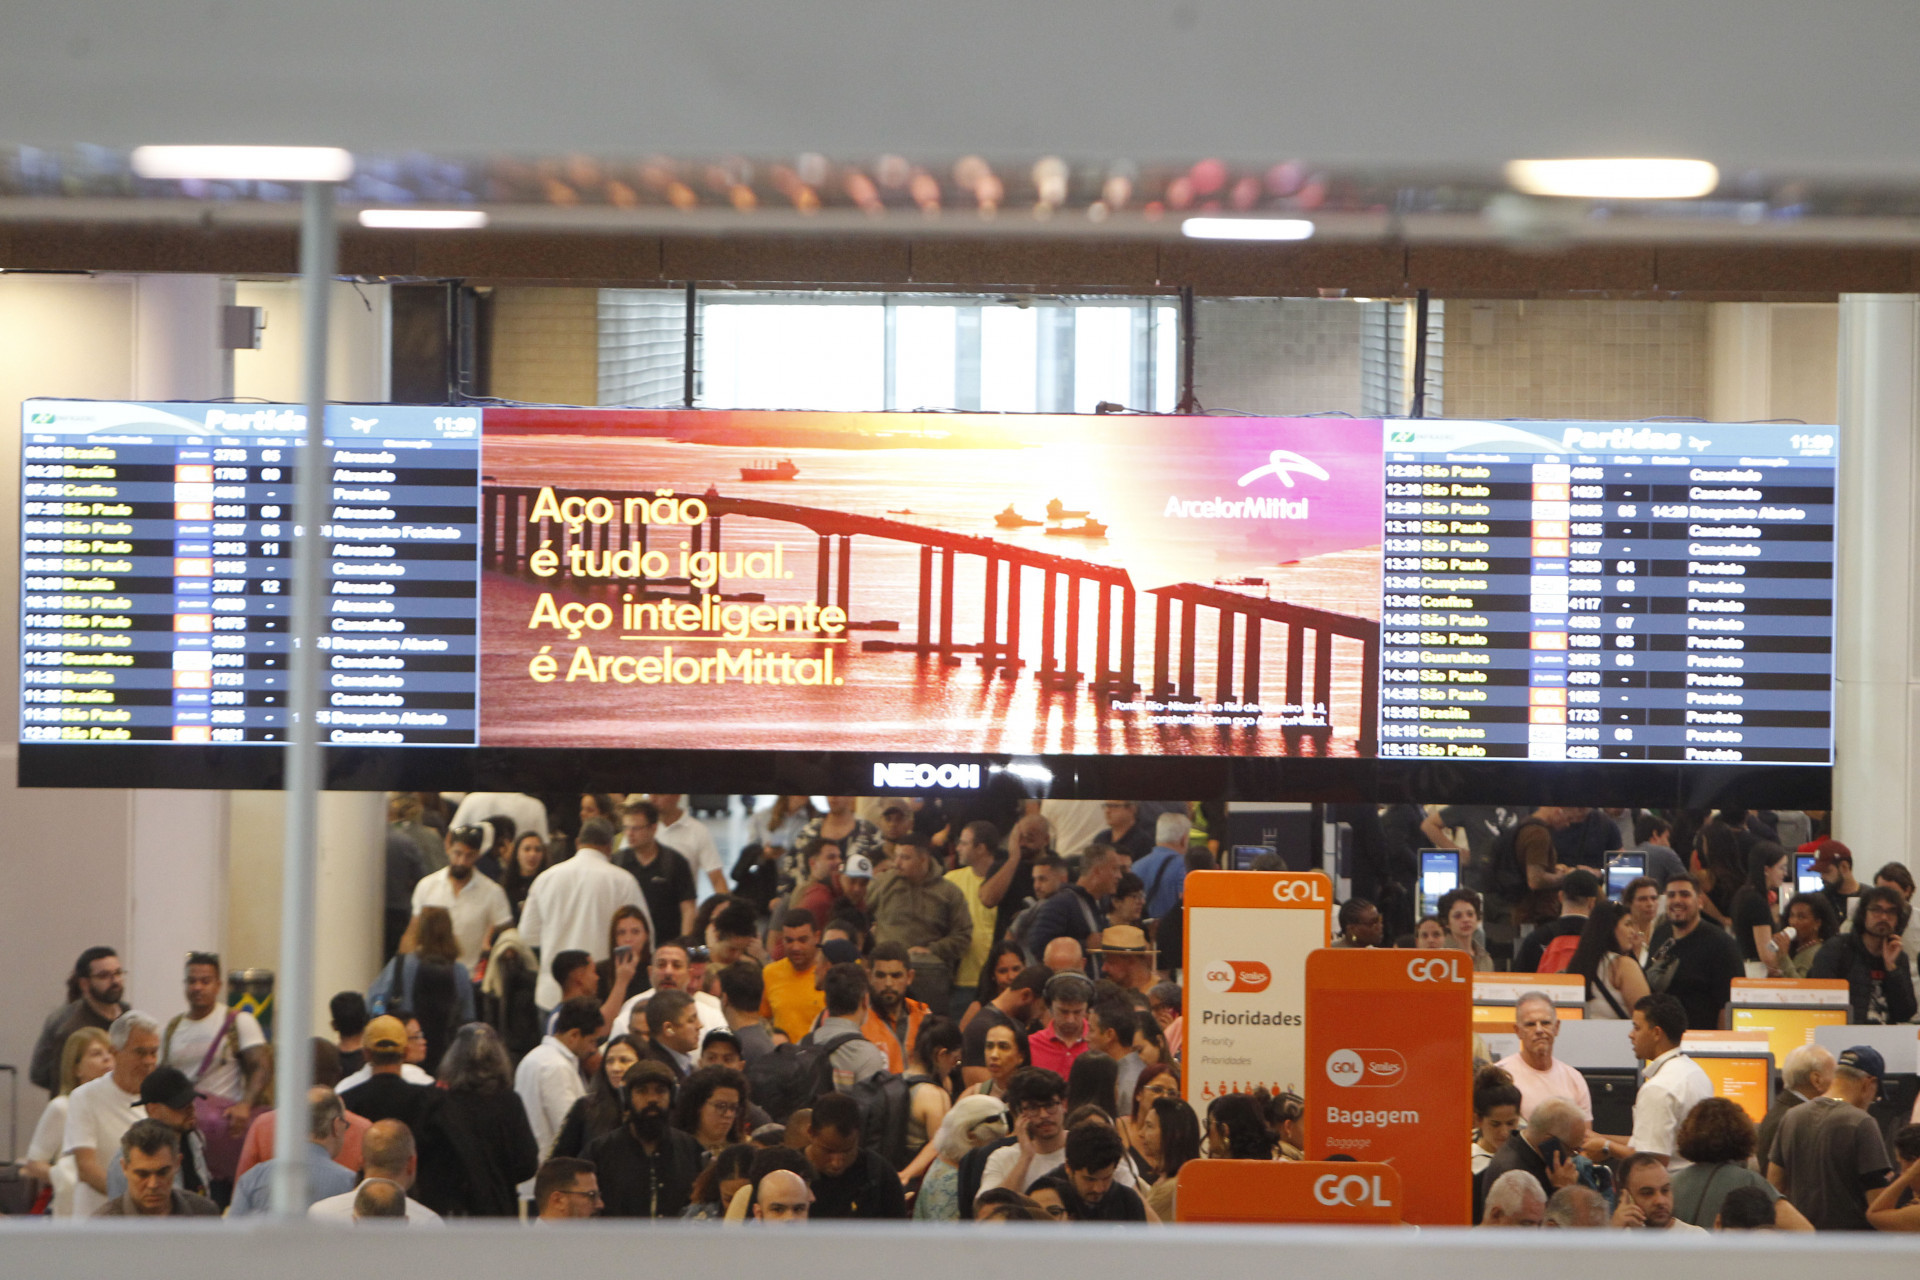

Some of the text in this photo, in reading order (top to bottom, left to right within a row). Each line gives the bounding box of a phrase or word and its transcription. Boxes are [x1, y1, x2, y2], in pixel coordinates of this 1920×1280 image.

[205, 410, 307, 430] Partida
[1562, 428, 1682, 450] Partidas
[1422, 465, 1449, 477] São
[1451, 466, 1490, 478] Paulo
[1423, 484, 1449, 495] São
[1451, 484, 1489, 496] Paulo
[530, 486, 708, 534] Aço não
[1163, 496, 1308, 519] ArcelorMittal
[1421, 502, 1449, 514] São
[1451, 503, 1489, 515] Paulo
[1422, 521, 1448, 533] São
[1451, 522, 1489, 533] Paulo
[262, 543, 278, 554] 11
[1421, 539, 1448, 551] São
[1450, 540, 1489, 552] Paulo
[530, 540, 794, 588] é tudo igual.
[1421, 558, 1448, 570] São
[1450, 559, 1488, 570] Paulo
[262, 580, 279, 592] 12
[1569, 598, 1601, 609] 4117
[528, 593, 847, 640] Aço inteligente
[1420, 614, 1447, 626] São
[1449, 614, 1488, 626] Paulo
[1420, 632, 1447, 644] São
[1449, 633, 1487, 645] Paulo
[529, 646, 844, 685] é ArcelorMittal.
[1420, 670, 1446, 681] São
[1449, 670, 1487, 682] Paulo
[1419, 688, 1446, 700] São
[1448, 689, 1487, 701] Paulo
[1418, 744, 1445, 756] São
[1447, 745, 1485, 757] Paulo
[873, 763, 980, 788] NEOOH
[1273, 880, 1325, 902] GOL
[1407, 957, 1466, 983] GOL
[1206, 971, 1269, 983] GOL Smiles
[1202, 1010, 1302, 1026] Prioridades
[1201, 1036, 1235, 1048] Priority
[1201, 1055, 1253, 1065] Prioridades
[1331, 1061, 1402, 1074] GOL Smiles
[1326, 1106, 1420, 1128] Bagagem
[1326, 1136, 1372, 1149] Baggage
[1313, 1174, 1392, 1207] GOL
